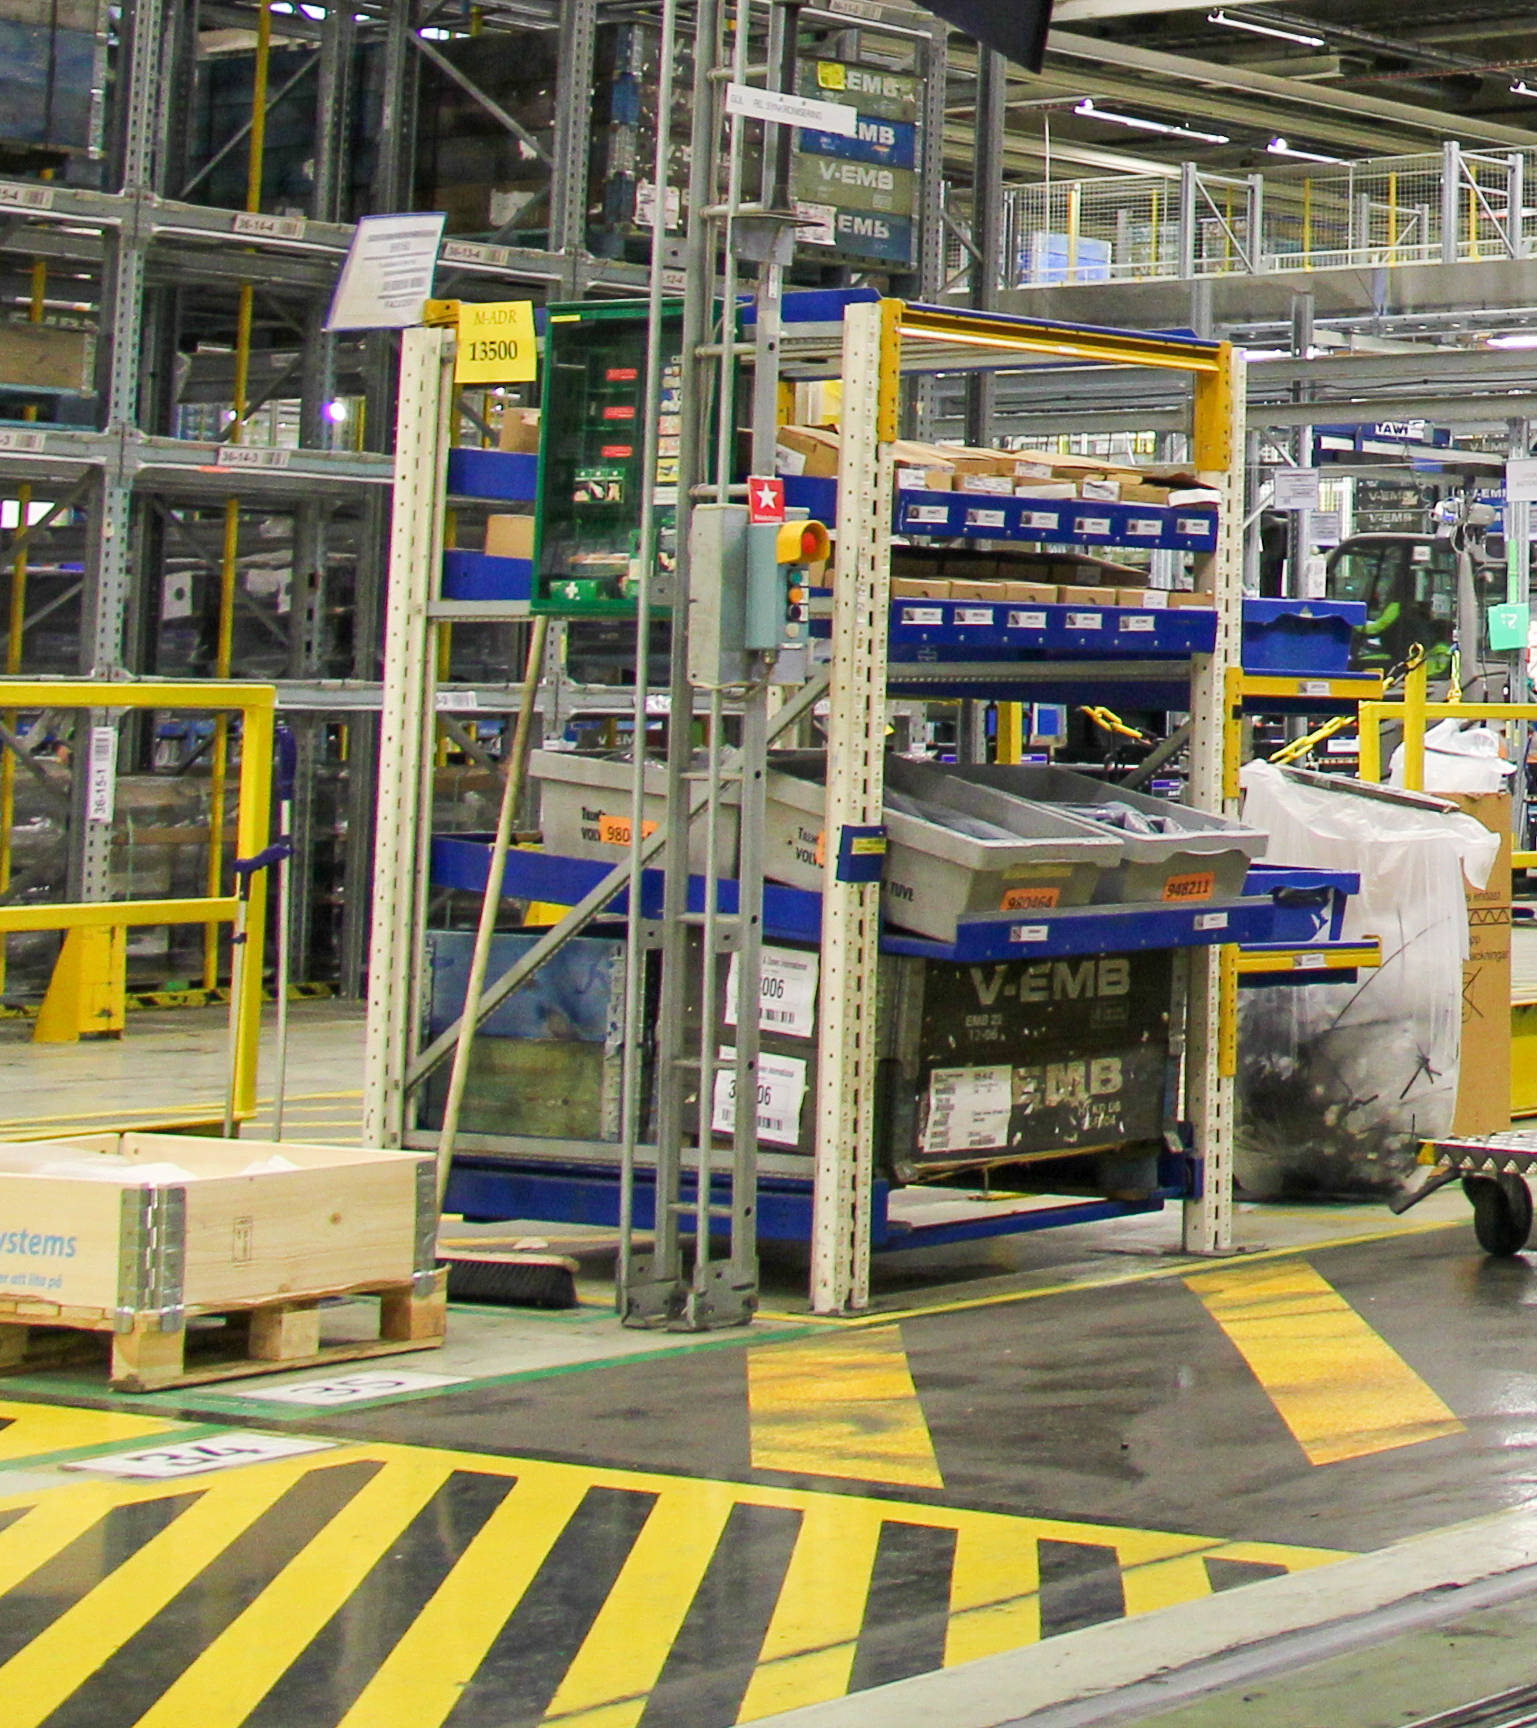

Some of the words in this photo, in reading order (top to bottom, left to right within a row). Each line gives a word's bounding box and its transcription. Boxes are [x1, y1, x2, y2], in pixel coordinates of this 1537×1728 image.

[855, 122, 895, 147] MB
[469, 339, 519, 362] 13500
[760, 977, 785, 1000] 006
[970, 958, 1131, 1006] V-EMB
[290, 1377, 405, 1397] 35
[125, 1444, 263, 1468] 34
